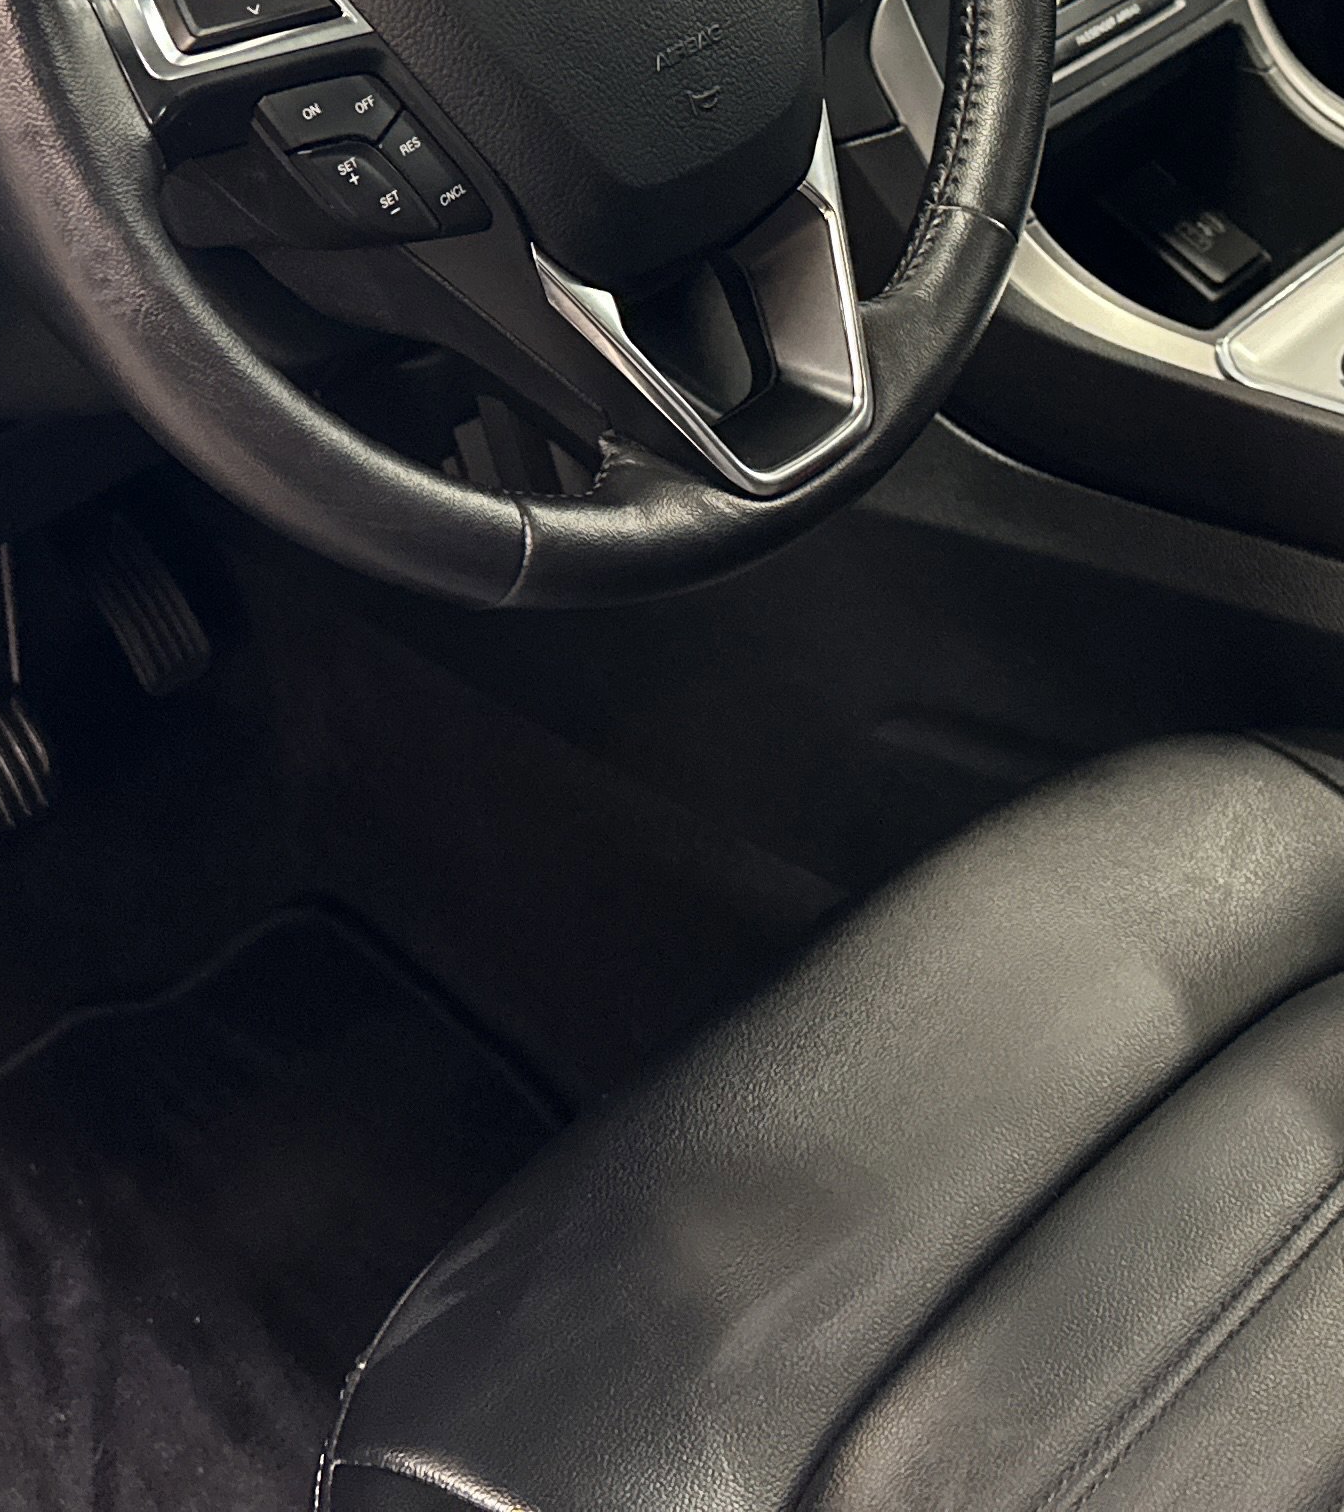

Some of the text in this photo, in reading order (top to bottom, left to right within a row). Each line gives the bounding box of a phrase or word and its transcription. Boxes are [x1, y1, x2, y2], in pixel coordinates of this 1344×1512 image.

[302, 103, 323, 120] ON
[355, 94, 375, 114] OFF
[399, 136, 422, 157] RES
[337, 156, 358, 176] SET
[379, 189, 400, 209] SET
[439, 184, 468, 207] CNCL
